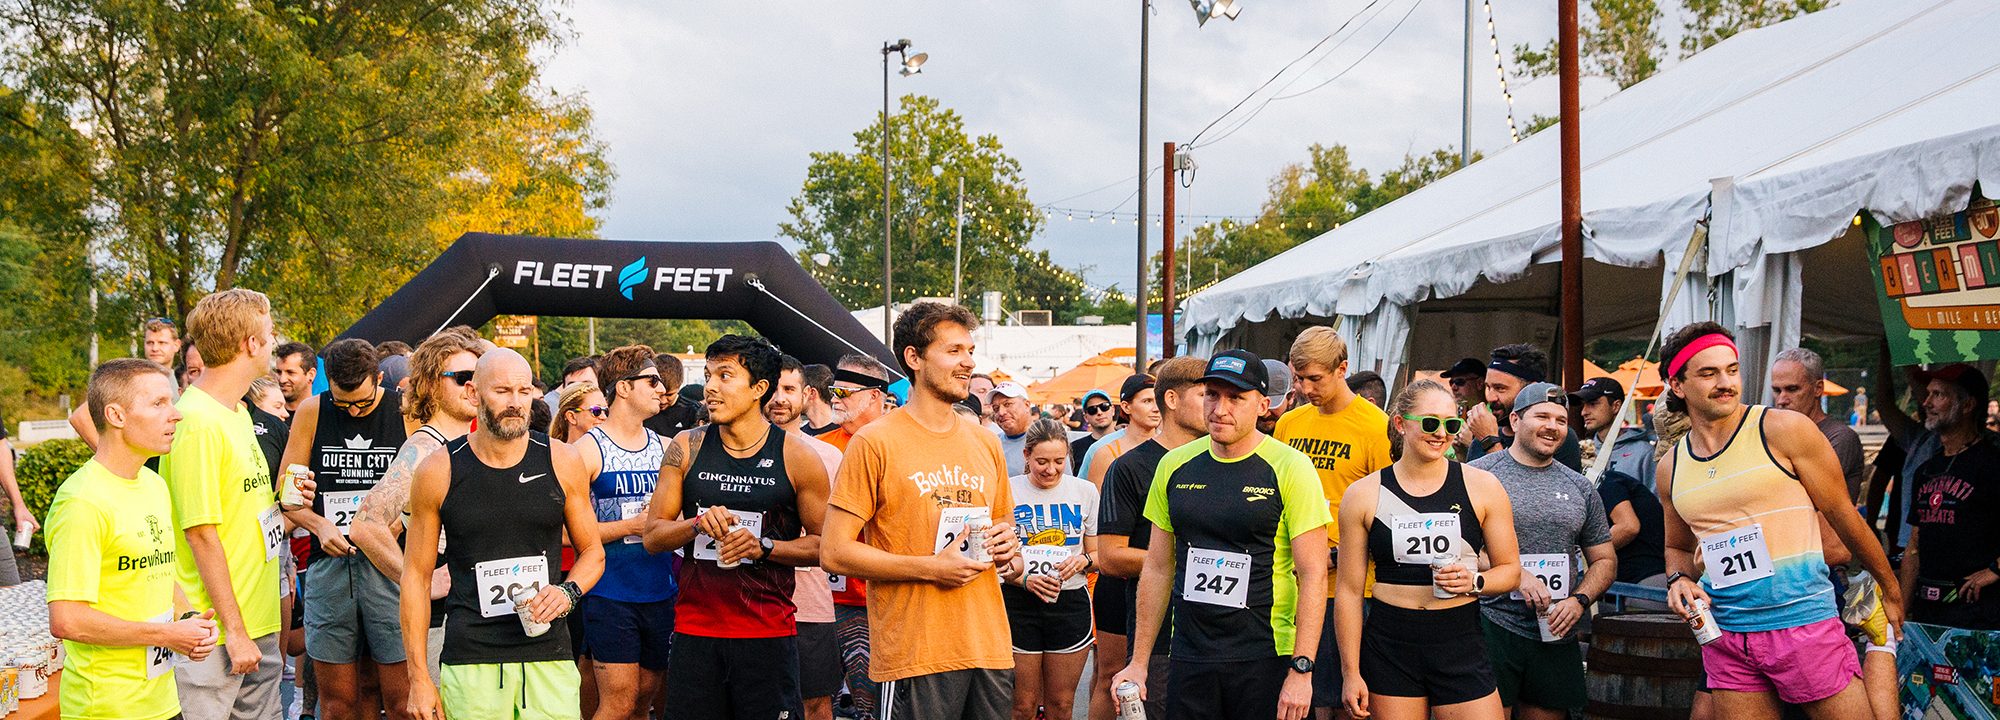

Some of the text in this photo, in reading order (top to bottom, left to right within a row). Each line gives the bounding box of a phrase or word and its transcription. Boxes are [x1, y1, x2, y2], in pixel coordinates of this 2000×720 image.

[1935, 228, 1956, 241] FEET
[513, 260, 734, 293] FLEET FEET
[1886, 258, 1951, 288] BEER
[1936, 311, 1962, 325] MILE
[1984, 310, 2000, 324] BE
[322, 453, 362, 469] QUEEN
[757, 458, 774, 468] NB
[341, 469, 374, 478] RUNNING
[698, 471, 776, 486] CINCINNATUS
[907, 464, 985, 497] Bockfest
[615, 473, 631, 495] AL
[720, 483, 752, 493] ELITE
[1242, 486, 1276, 496] BROOKS
[944, 516, 963, 524] FLEET
[1014, 503, 1083, 534] RUN
[1434, 520, 1456, 528] FEET
[268, 524, 283, 550] 213
[1707, 532, 1759, 552] FLEET FEET
[1406, 536, 1450, 555] 210
[1028, 561, 1061, 575] 20
[1193, 556, 1246, 570] FLEET FEET
[1720, 550, 1757, 577] 211
[483, 564, 543, 578] FLEET FEET
[1193, 572, 1239, 596] 247
